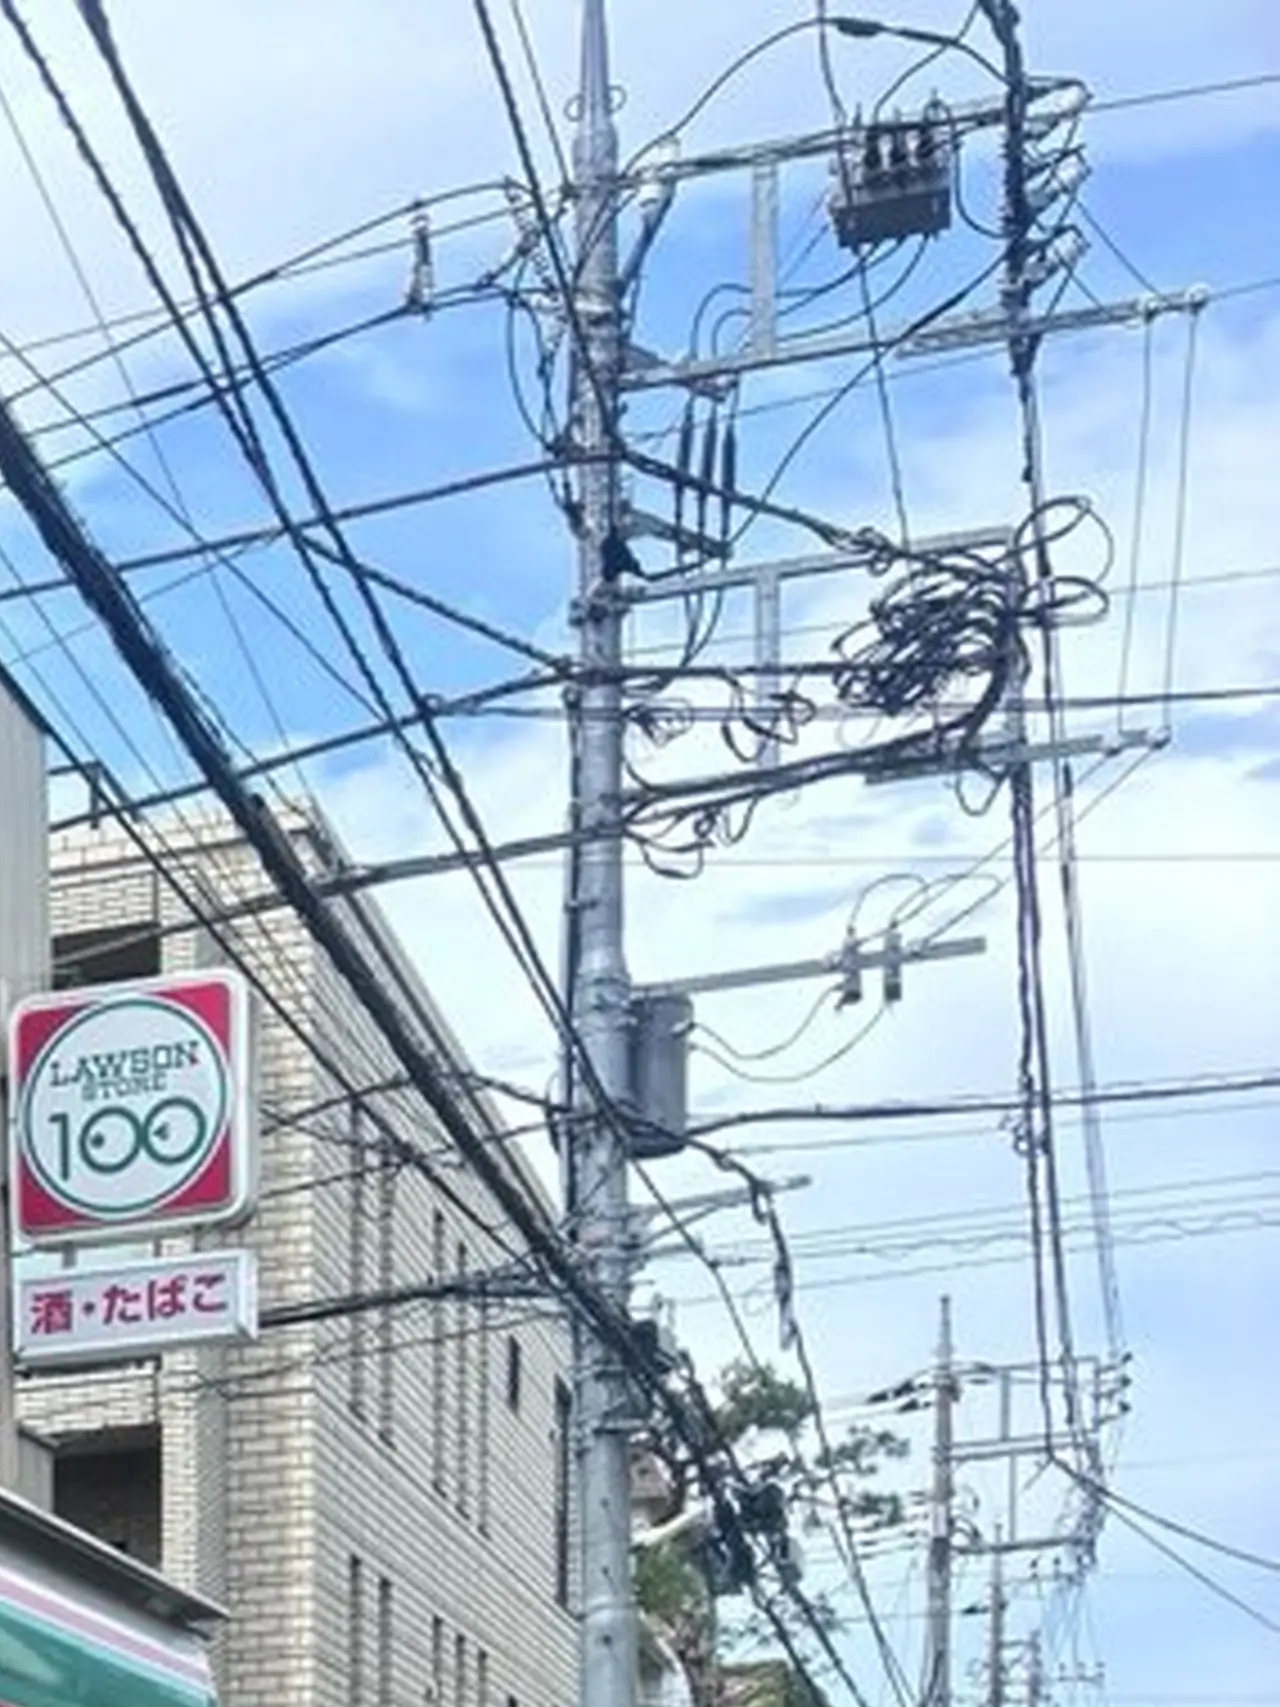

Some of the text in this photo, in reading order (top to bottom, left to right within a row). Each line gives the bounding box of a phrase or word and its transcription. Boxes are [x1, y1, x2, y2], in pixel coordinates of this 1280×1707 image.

[50, 1040, 202, 1088] LAWSON
[81, 1071, 168, 1101] STORE
[47, 1096, 207, 1183] 100
[29, 1273, 229, 1336] 酒・たばこ
